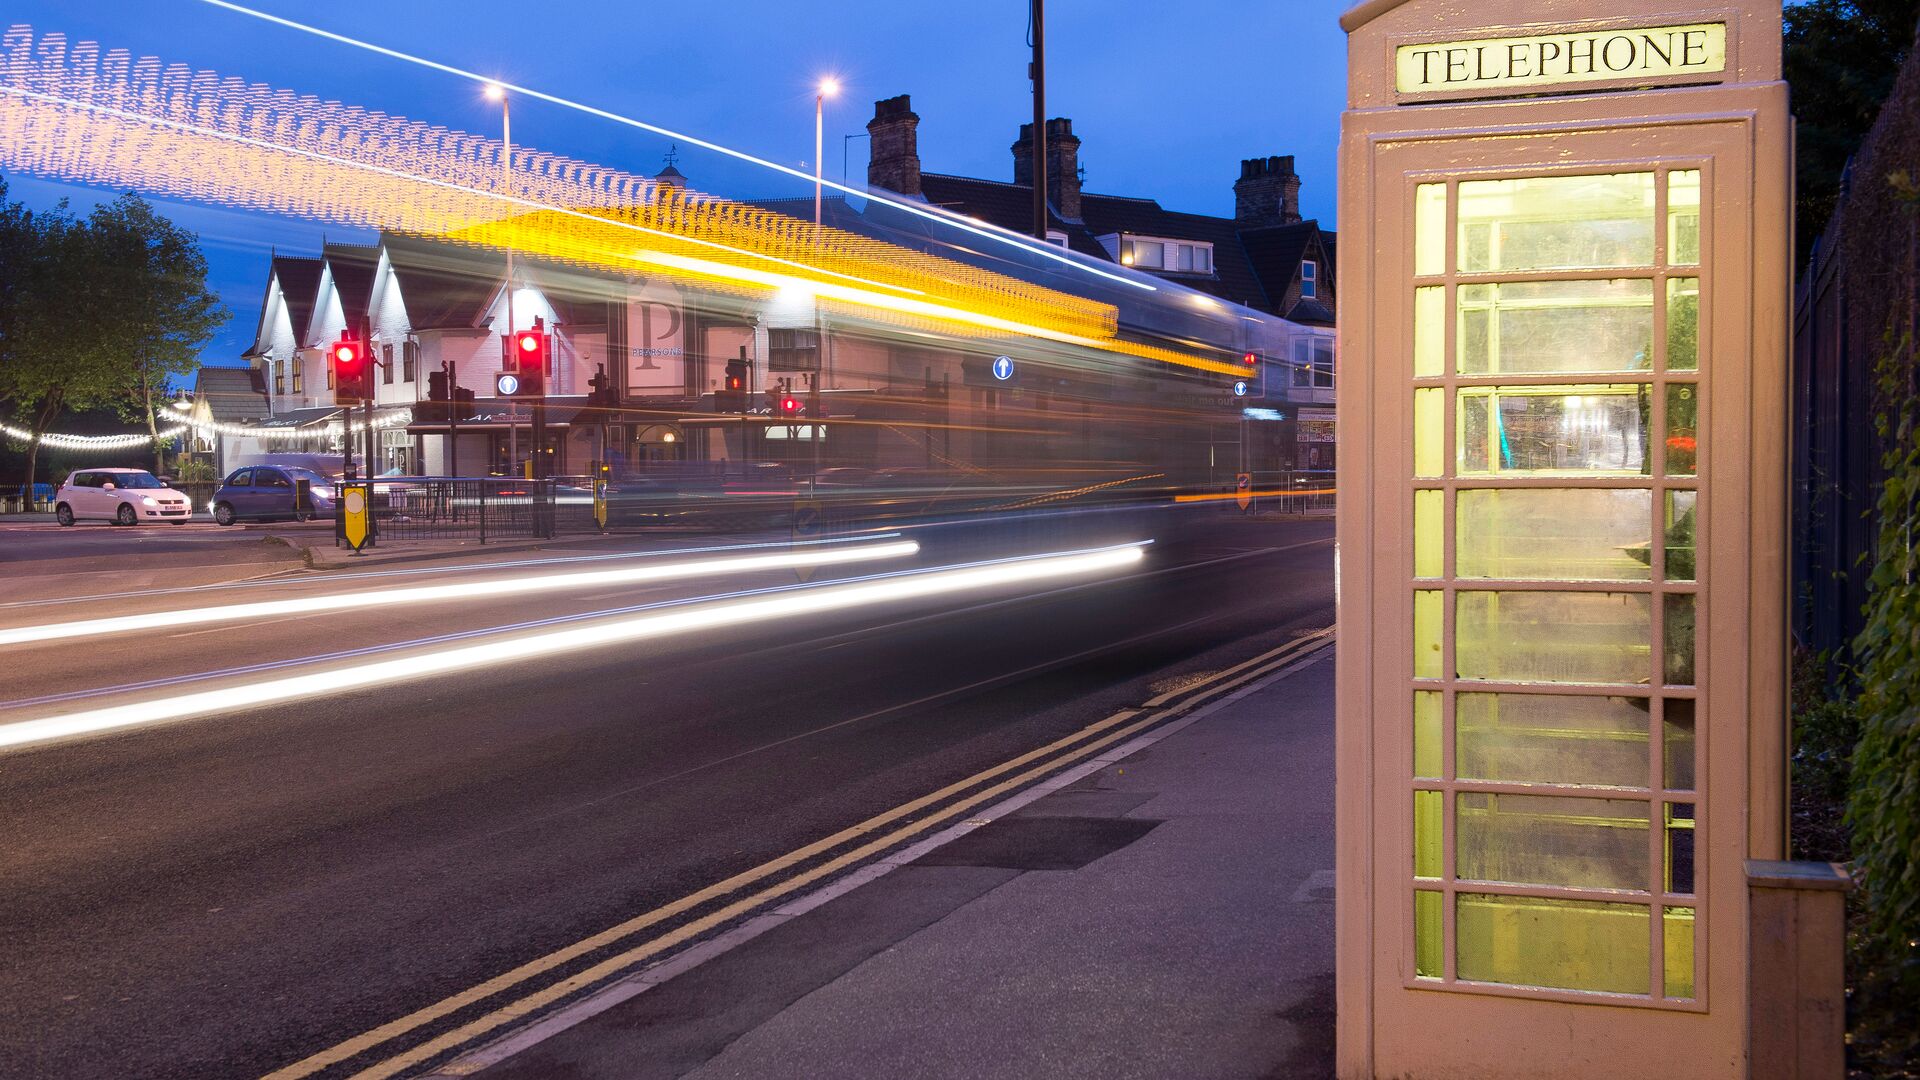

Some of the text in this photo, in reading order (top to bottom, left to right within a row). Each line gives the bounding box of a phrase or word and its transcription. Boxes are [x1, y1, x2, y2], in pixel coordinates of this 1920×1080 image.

[1411, 29, 1709, 84] TELEPHONE
[632, 348, 682, 357] PEARSONS
[633, 300, 681, 370] P
